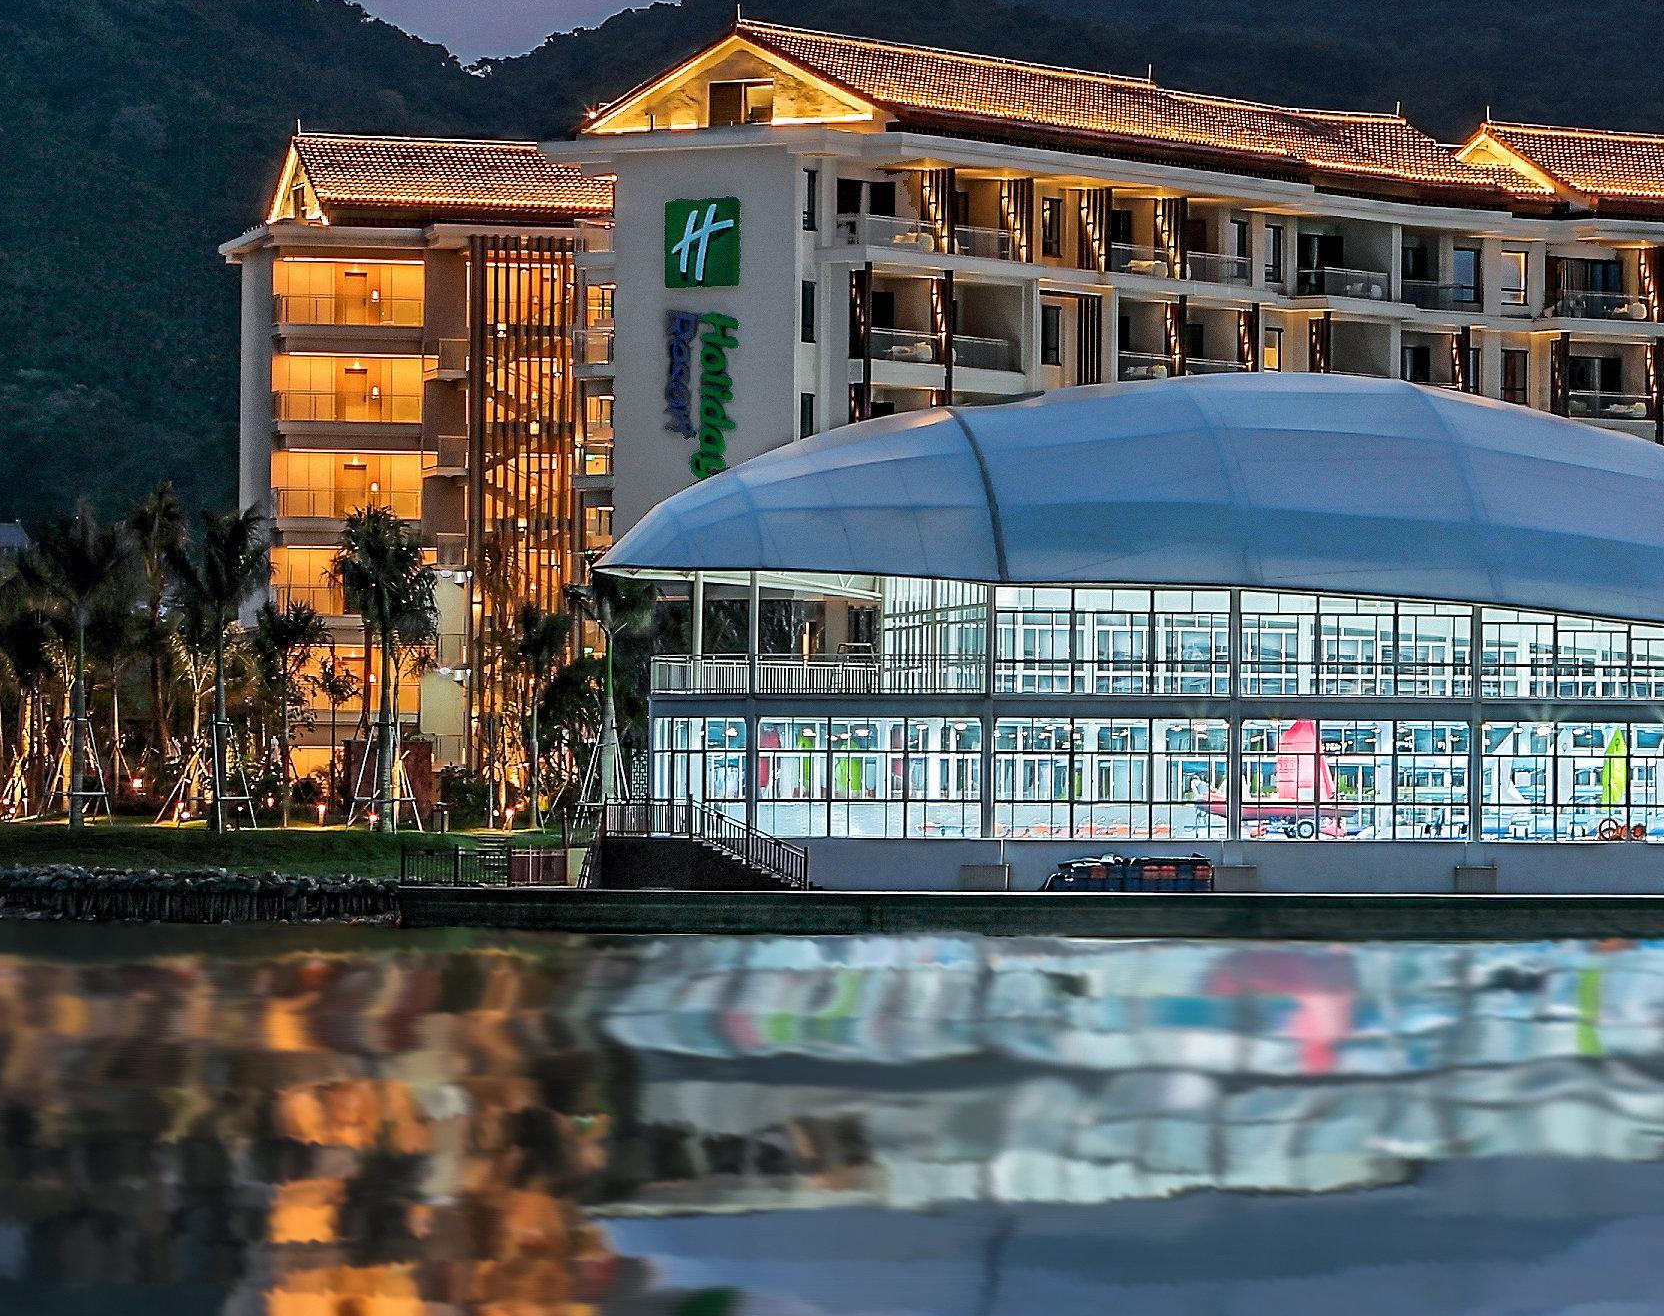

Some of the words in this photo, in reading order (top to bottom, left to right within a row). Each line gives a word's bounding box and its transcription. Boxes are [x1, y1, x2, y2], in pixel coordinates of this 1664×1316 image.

[671, 203, 734, 281] H
[664, 310, 698, 440] Resort
[690, 311, 740, 479] Holiday
